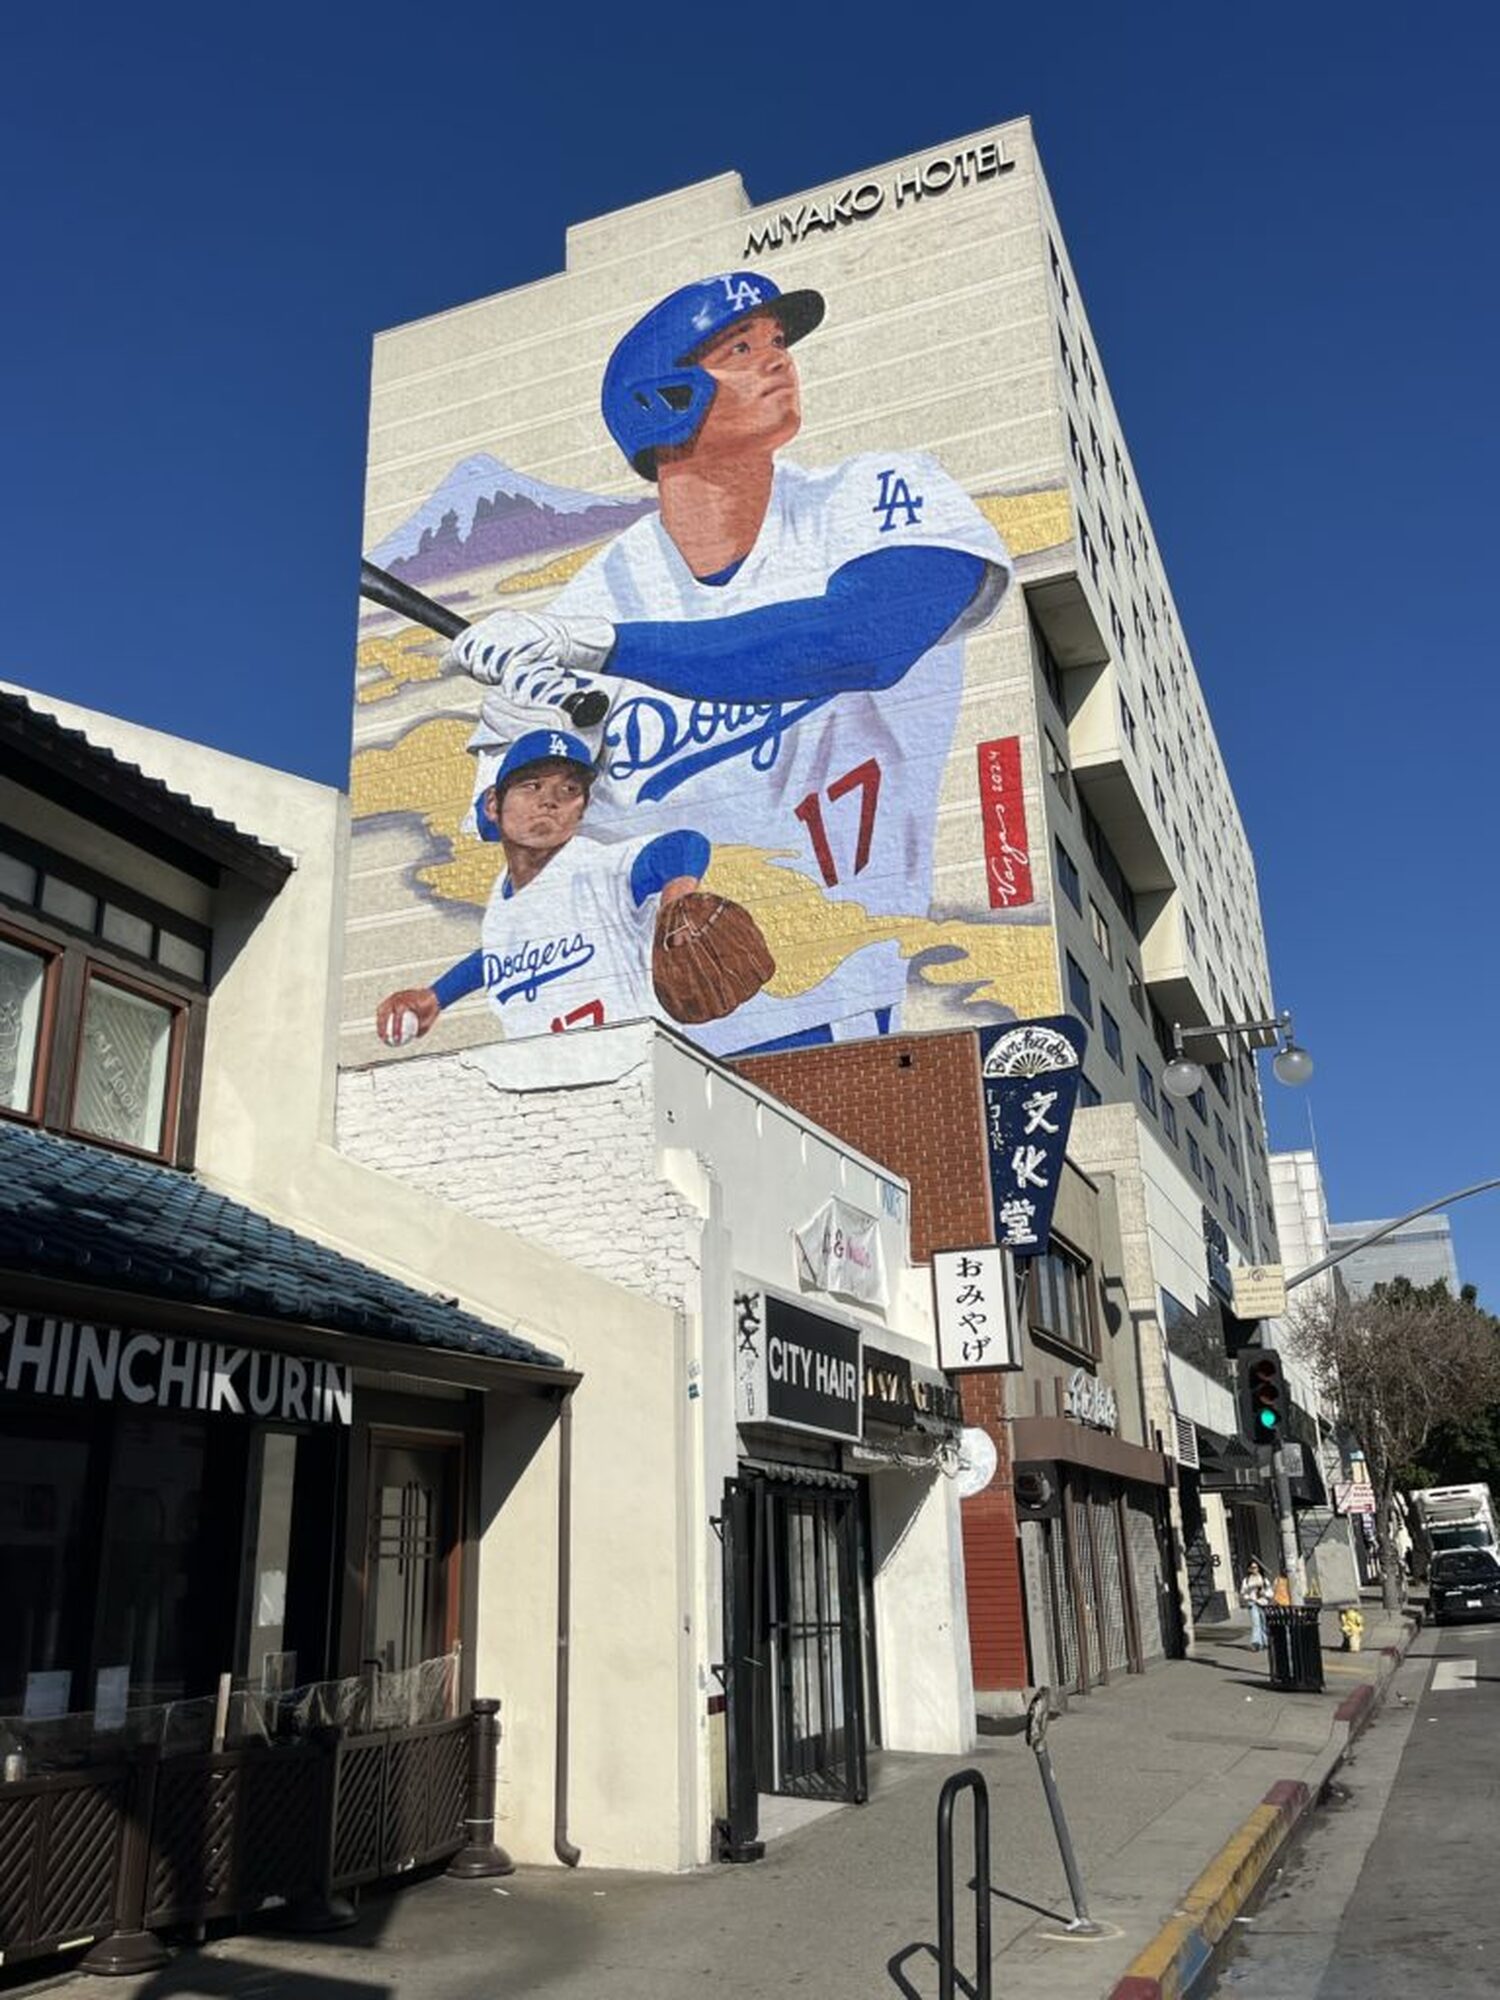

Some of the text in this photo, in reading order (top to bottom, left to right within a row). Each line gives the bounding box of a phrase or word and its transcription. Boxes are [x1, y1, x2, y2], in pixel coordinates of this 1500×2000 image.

[743, 140, 1016, 258] MIYAKO HOTEL
[720, 275, 763, 312] LA
[873, 470, 923, 532] LA
[549, 733, 568, 757] LA
[794, 757, 882, 888] 17
[484, 933, 594, 1003] Dodgers
[1000, 1090, 1060, 1245] 文化堂
[956, 1257, 992, 1362] おみやげ
[768, 1336, 813, 1389] CITY
[815, 1352, 857, 1403] HAIR
